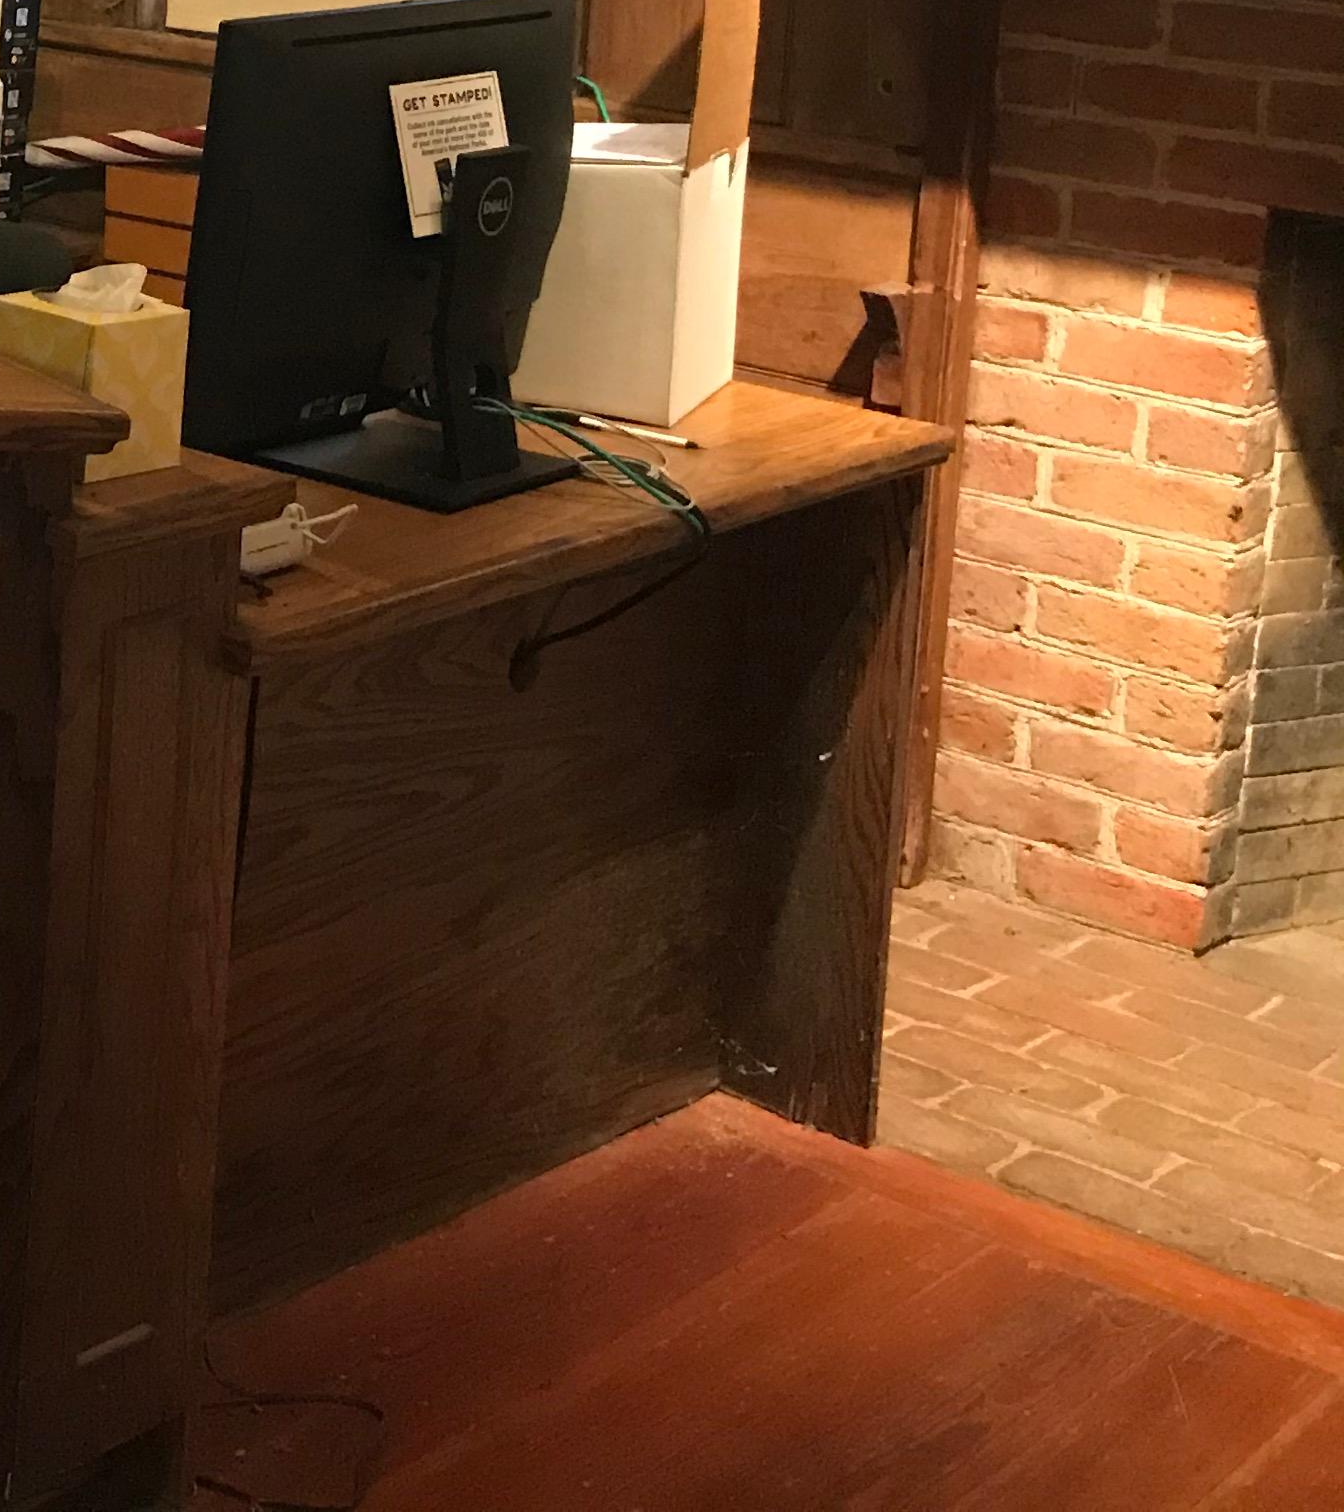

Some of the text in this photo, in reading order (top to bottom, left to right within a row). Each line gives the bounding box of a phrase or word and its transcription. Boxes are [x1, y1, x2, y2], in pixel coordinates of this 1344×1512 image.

[402, 86, 492, 111] GET STAMPED!
[483, 196, 508, 215] DELL
